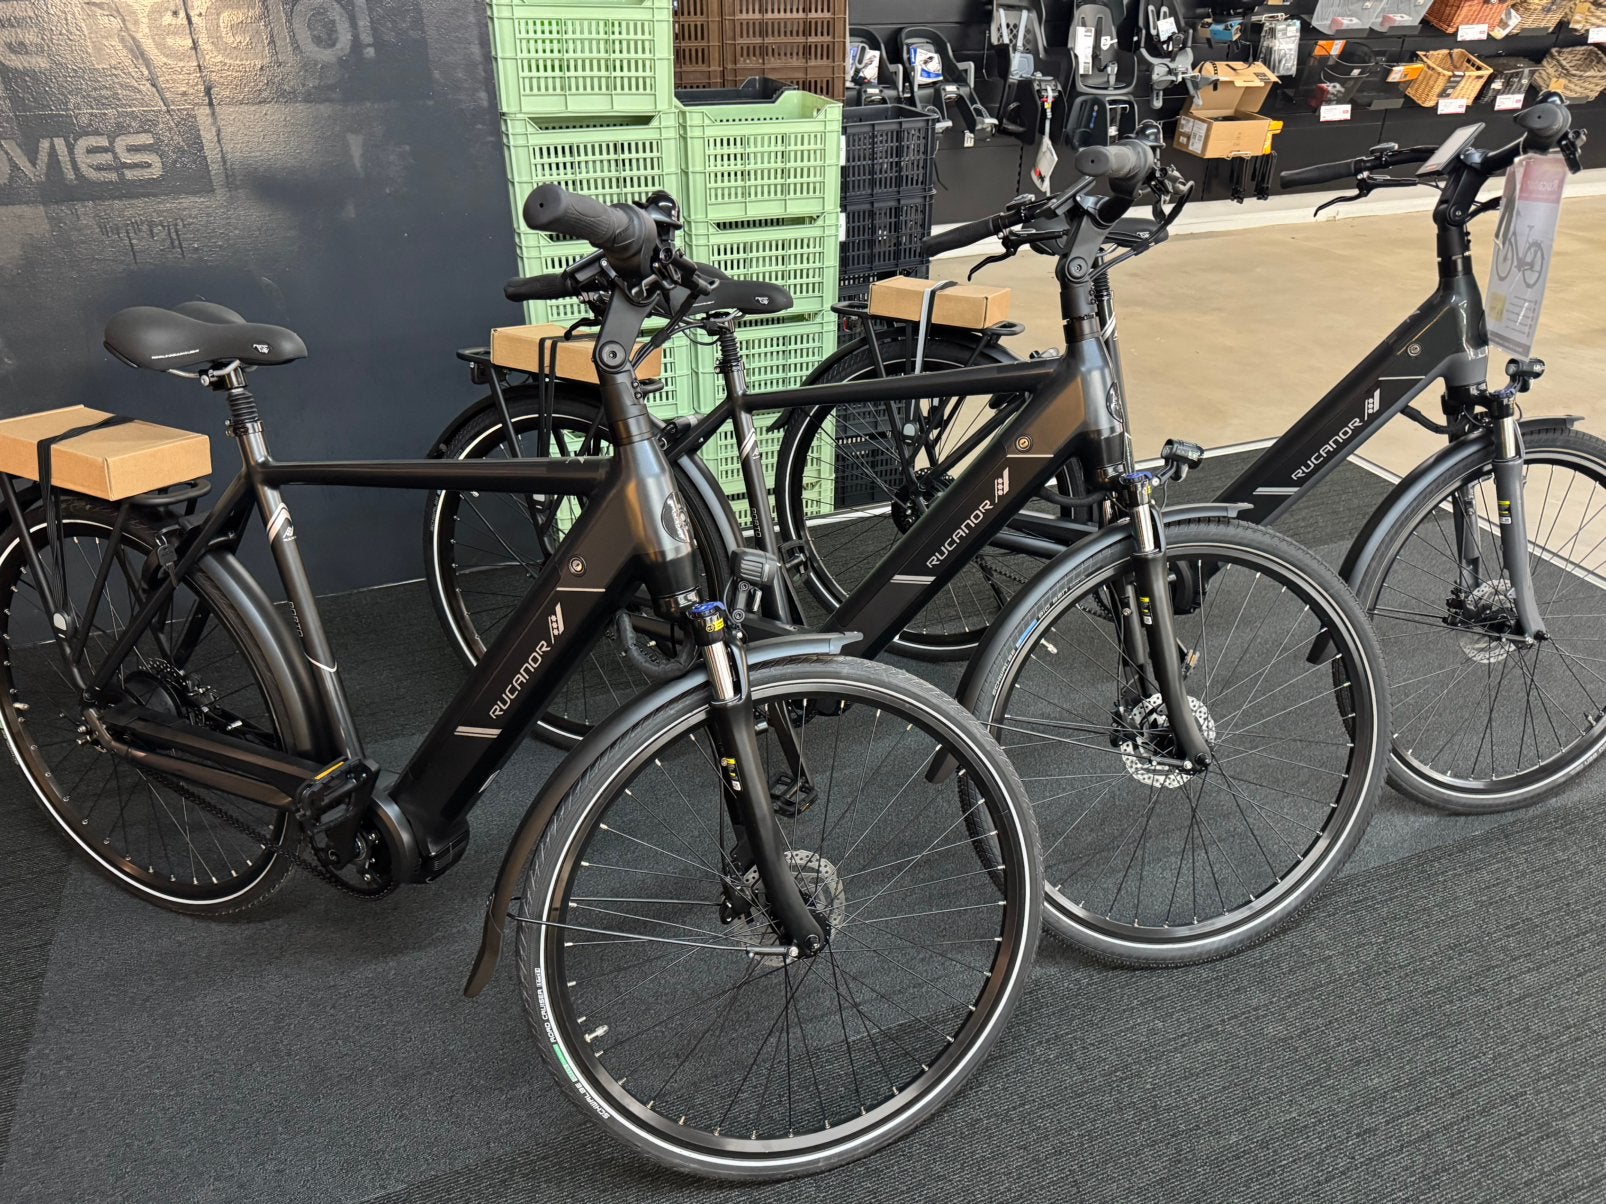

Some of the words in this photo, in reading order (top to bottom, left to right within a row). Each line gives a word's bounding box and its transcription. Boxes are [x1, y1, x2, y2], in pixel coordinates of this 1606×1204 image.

[0, 133, 164, 185] VIES
[1290, 417, 1364, 481] RUCANOR
[925, 499, 994, 569] RUCANOR
[489, 640, 551, 719] RUCANOR
[544, 1022, 557, 1044] ROAD
[575, 1081, 611, 1120] SCHWALBE
